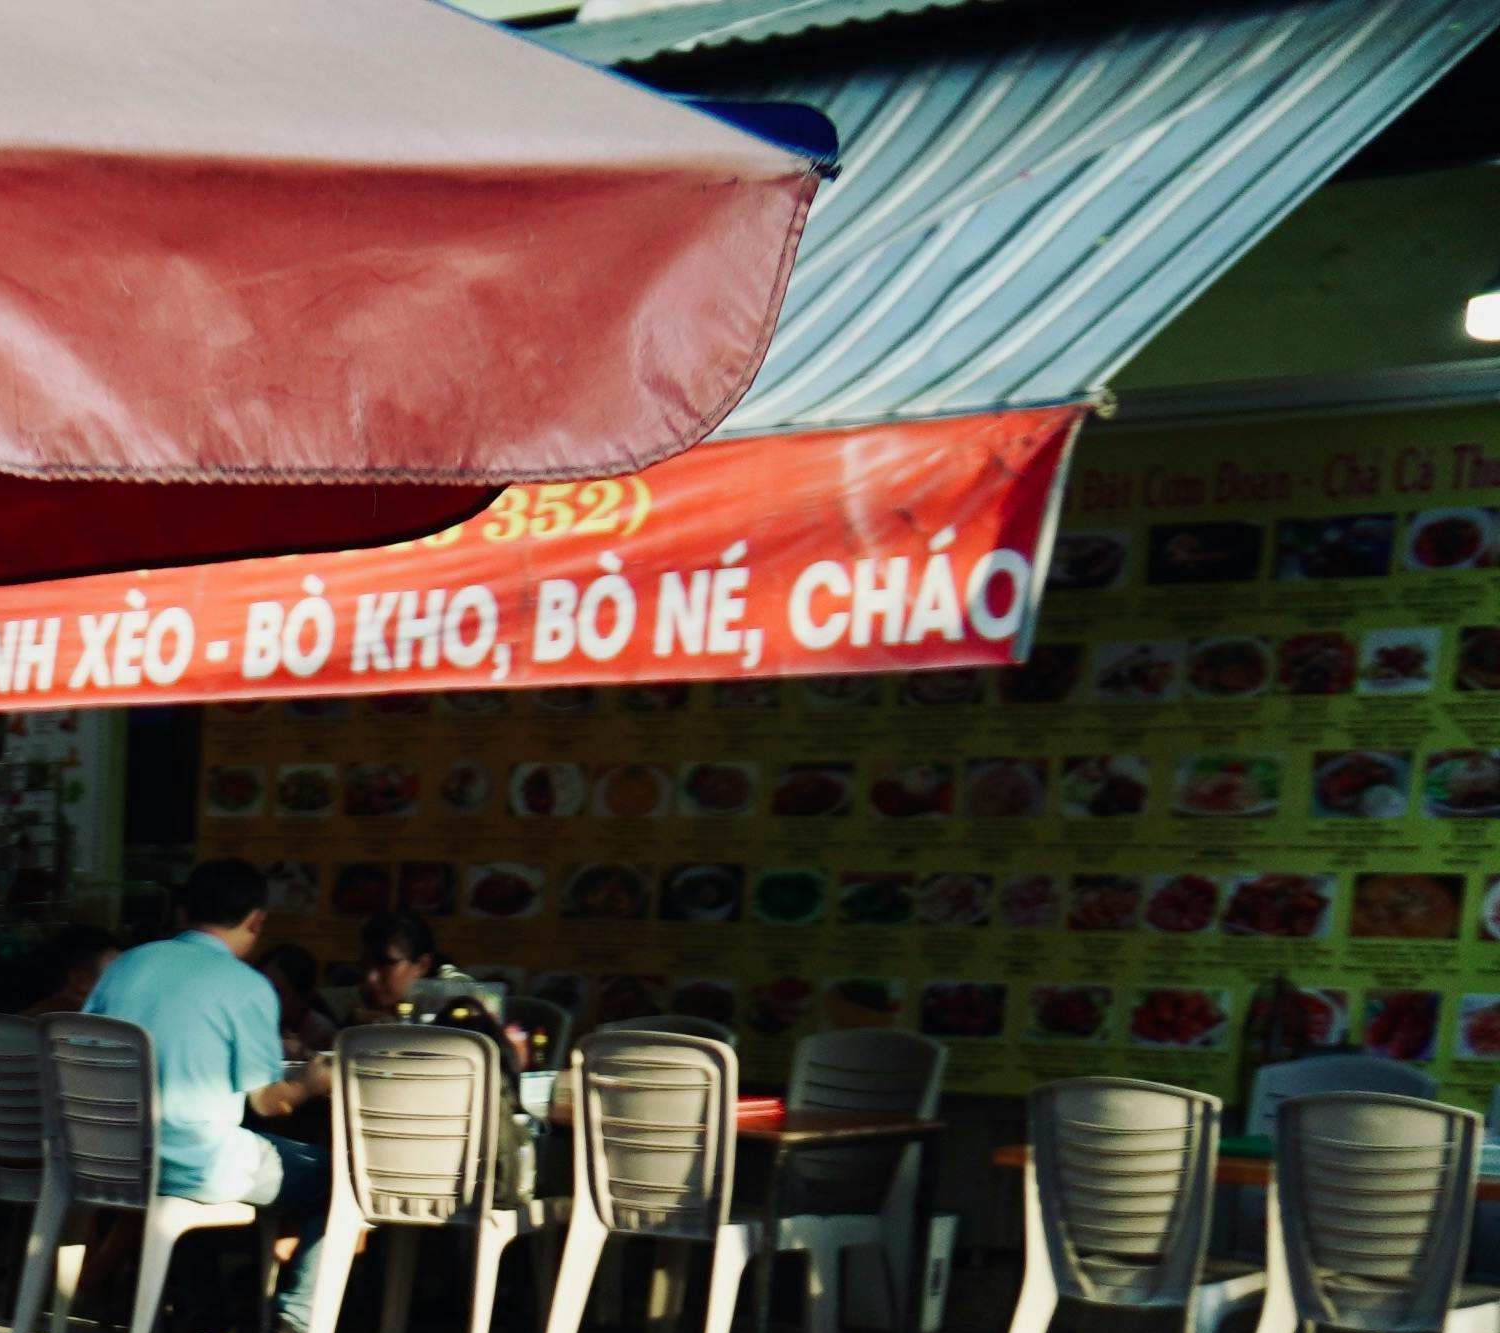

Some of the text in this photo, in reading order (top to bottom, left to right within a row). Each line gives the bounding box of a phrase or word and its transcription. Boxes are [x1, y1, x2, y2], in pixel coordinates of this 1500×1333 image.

[69, 588, 195, 686] XÈO
[242, 574, 336, 679] BÒ
[351, 584, 512, 681] KHO,
[533, 550, 637, 662] BÒ
[653, 540, 764, 669] NÉ,
[788, 526, 1032, 650] CHÁO
